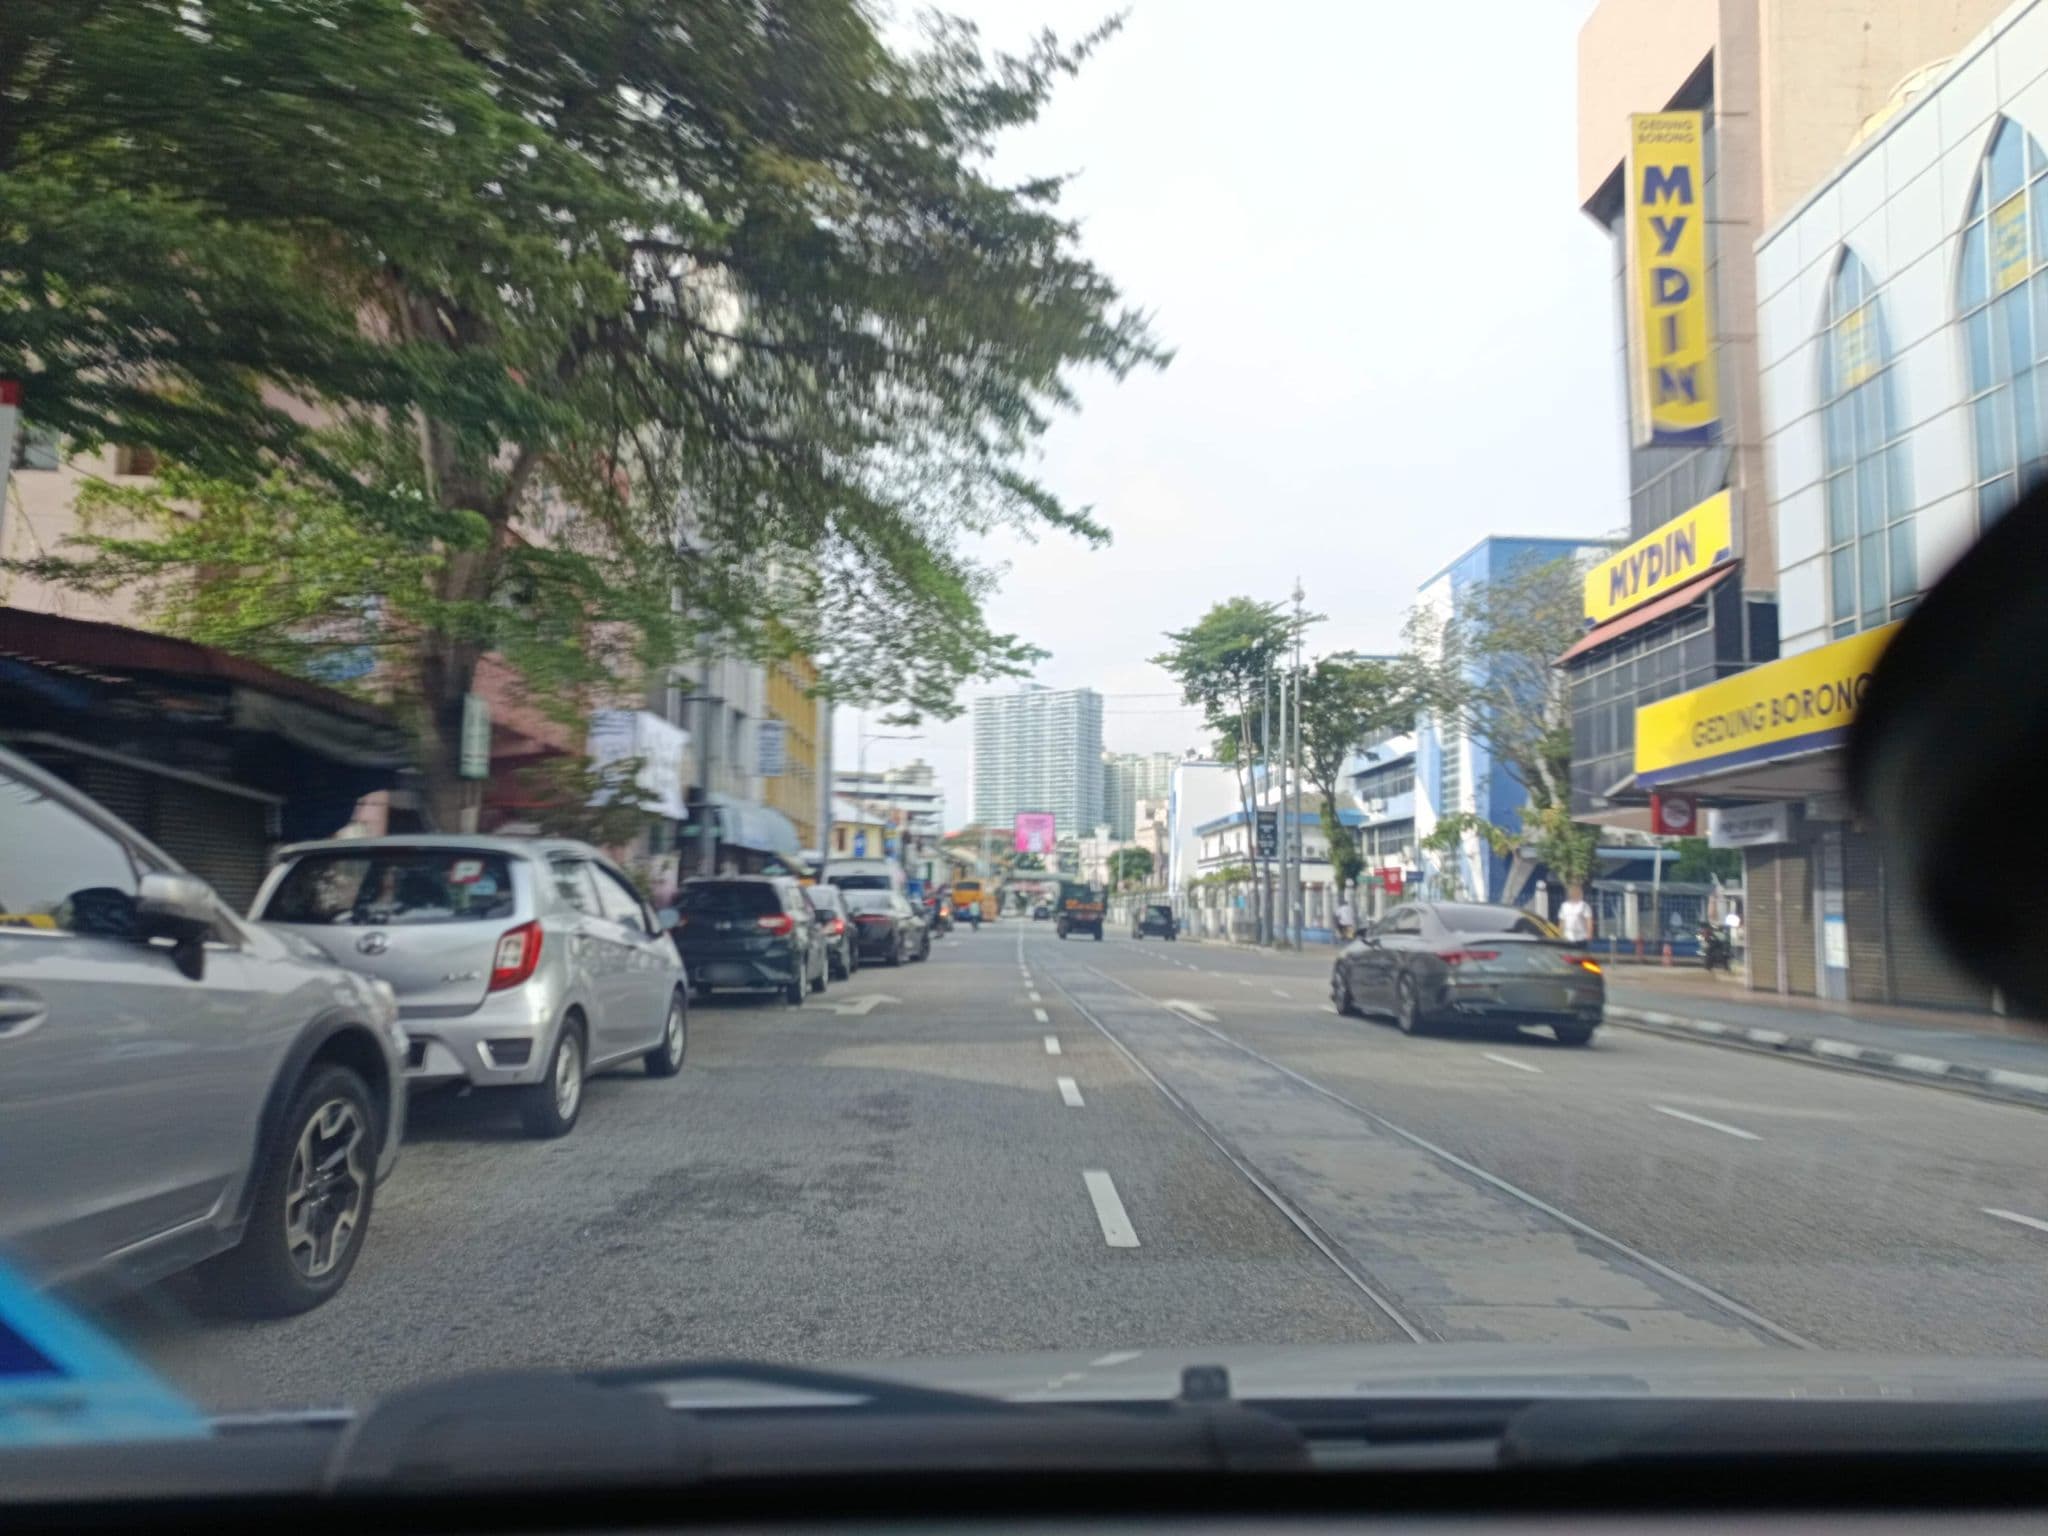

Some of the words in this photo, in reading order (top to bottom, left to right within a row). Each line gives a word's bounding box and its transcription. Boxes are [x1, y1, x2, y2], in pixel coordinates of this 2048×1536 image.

[1642, 164, 1700, 405] MYDIN
[1609, 521, 1696, 606] MYDIN
[1692, 703, 1766, 747] GEDUNG
